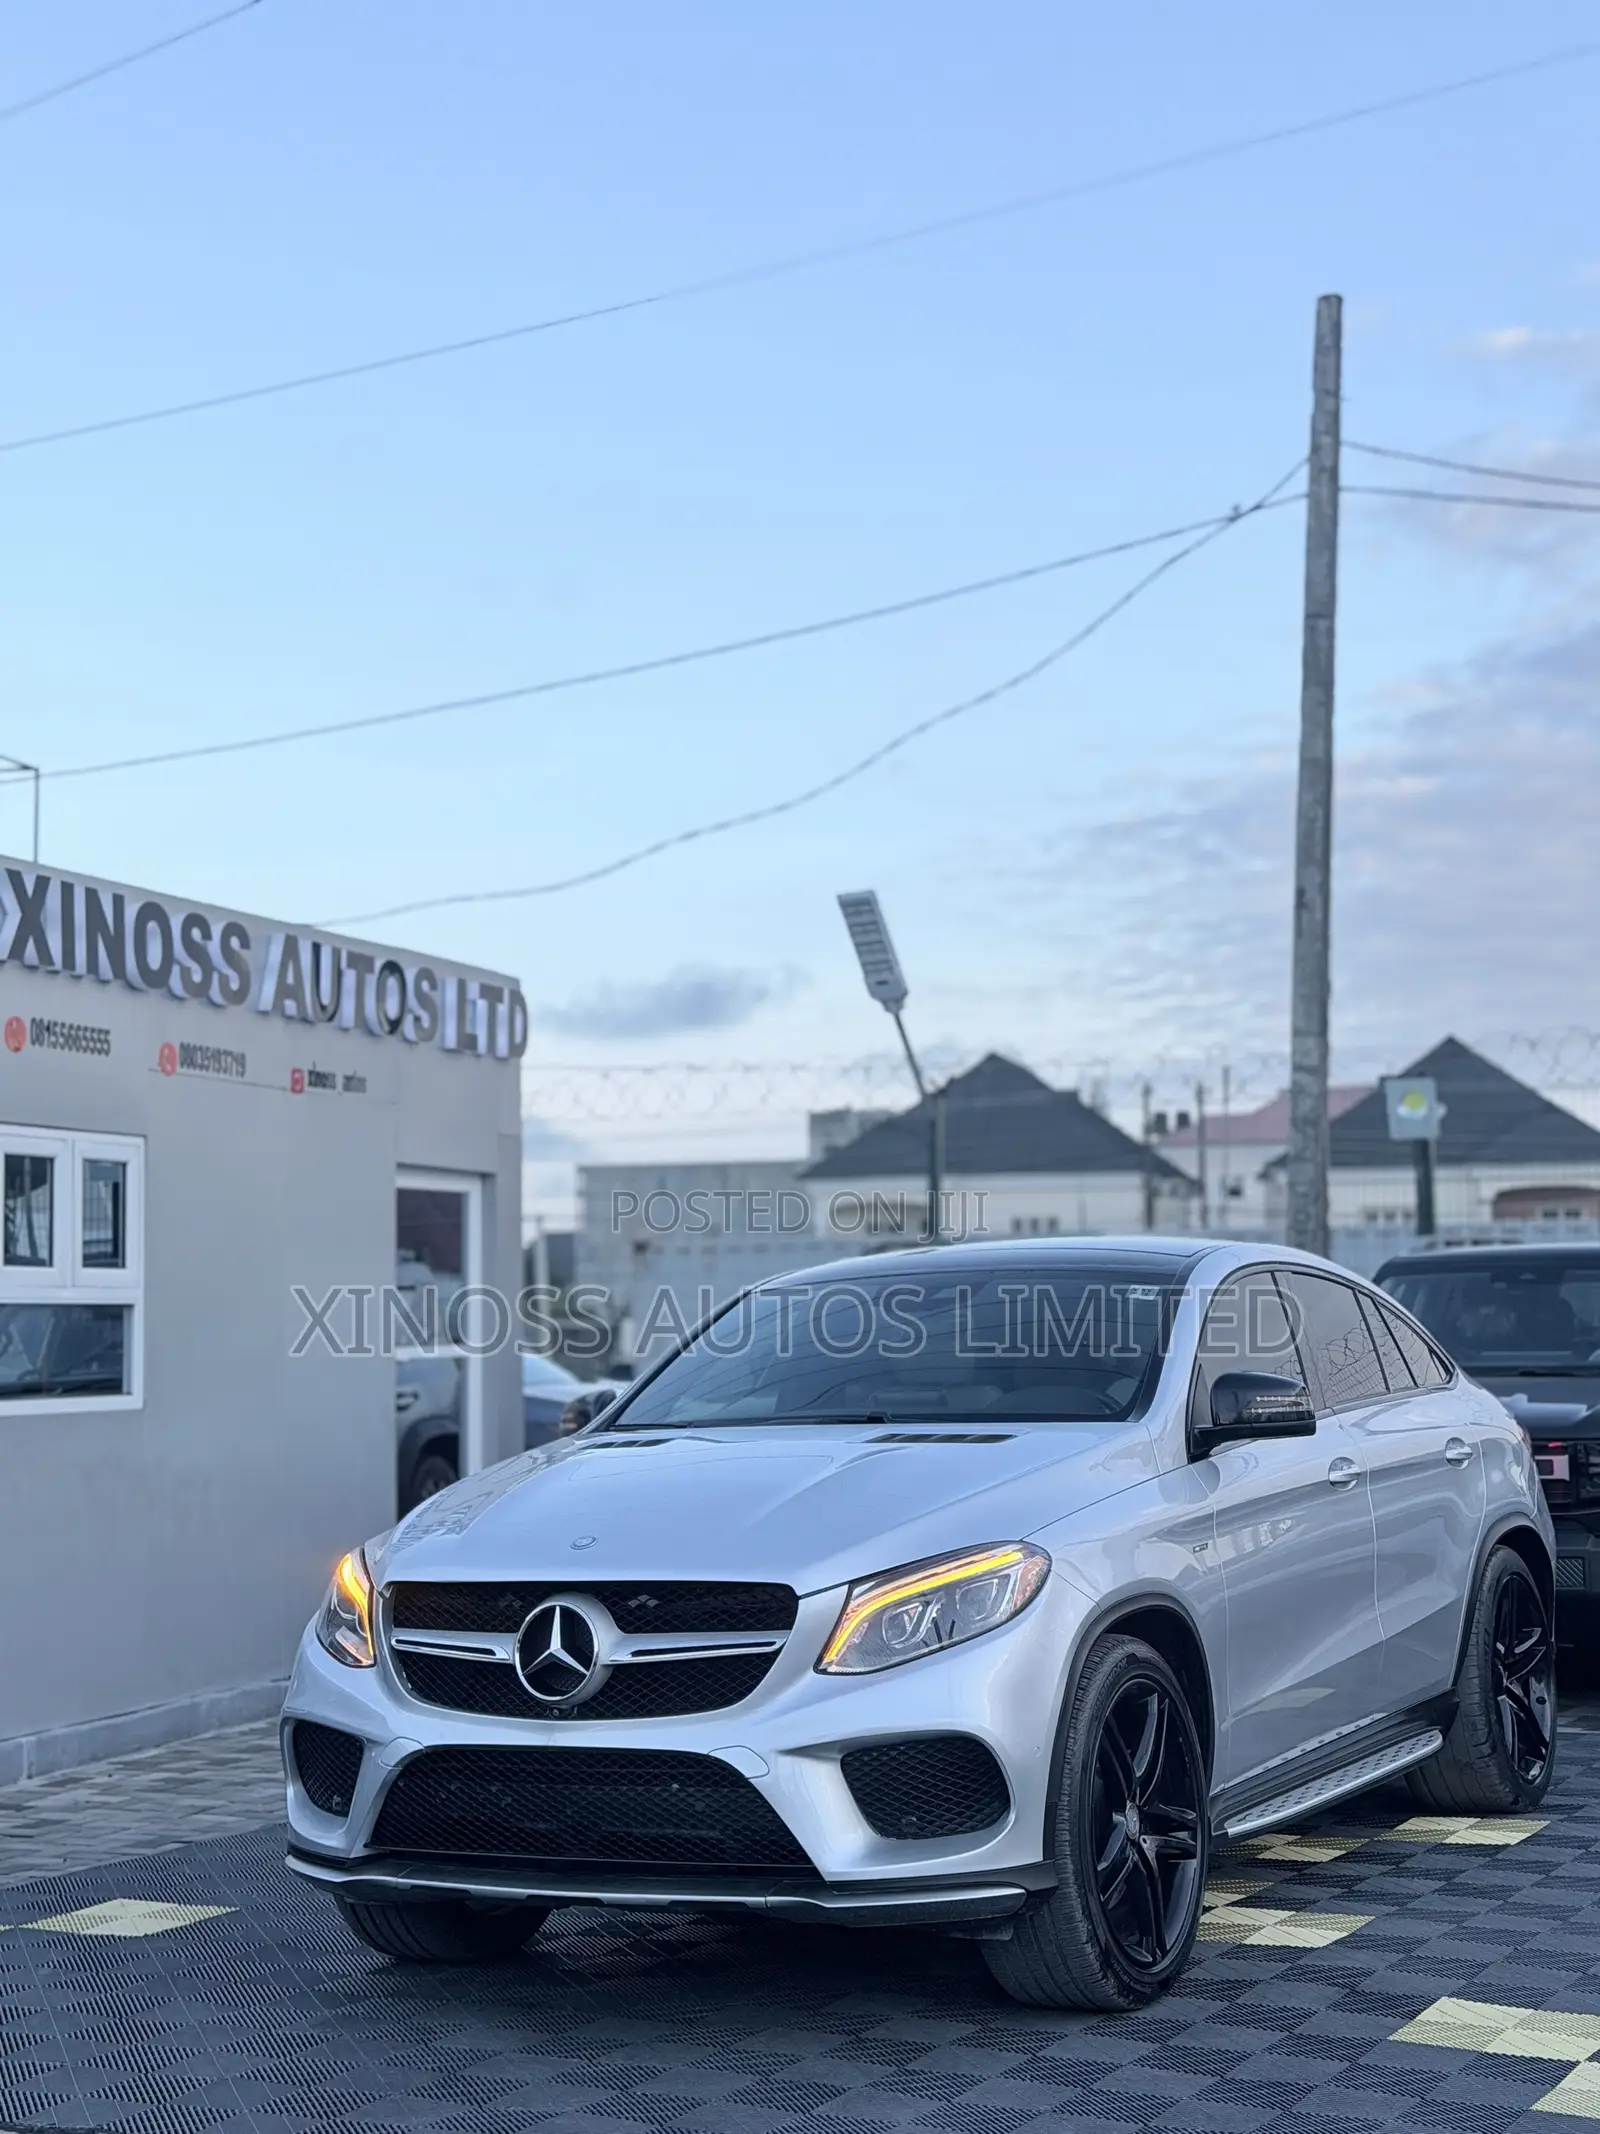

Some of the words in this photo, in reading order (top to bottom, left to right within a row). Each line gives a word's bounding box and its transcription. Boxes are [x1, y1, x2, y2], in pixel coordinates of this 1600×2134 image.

[3, 867, 253, 1007] XINOSS
[260, 932, 438, 1043] AUTOS
[445, 977, 528, 1060] LTD
